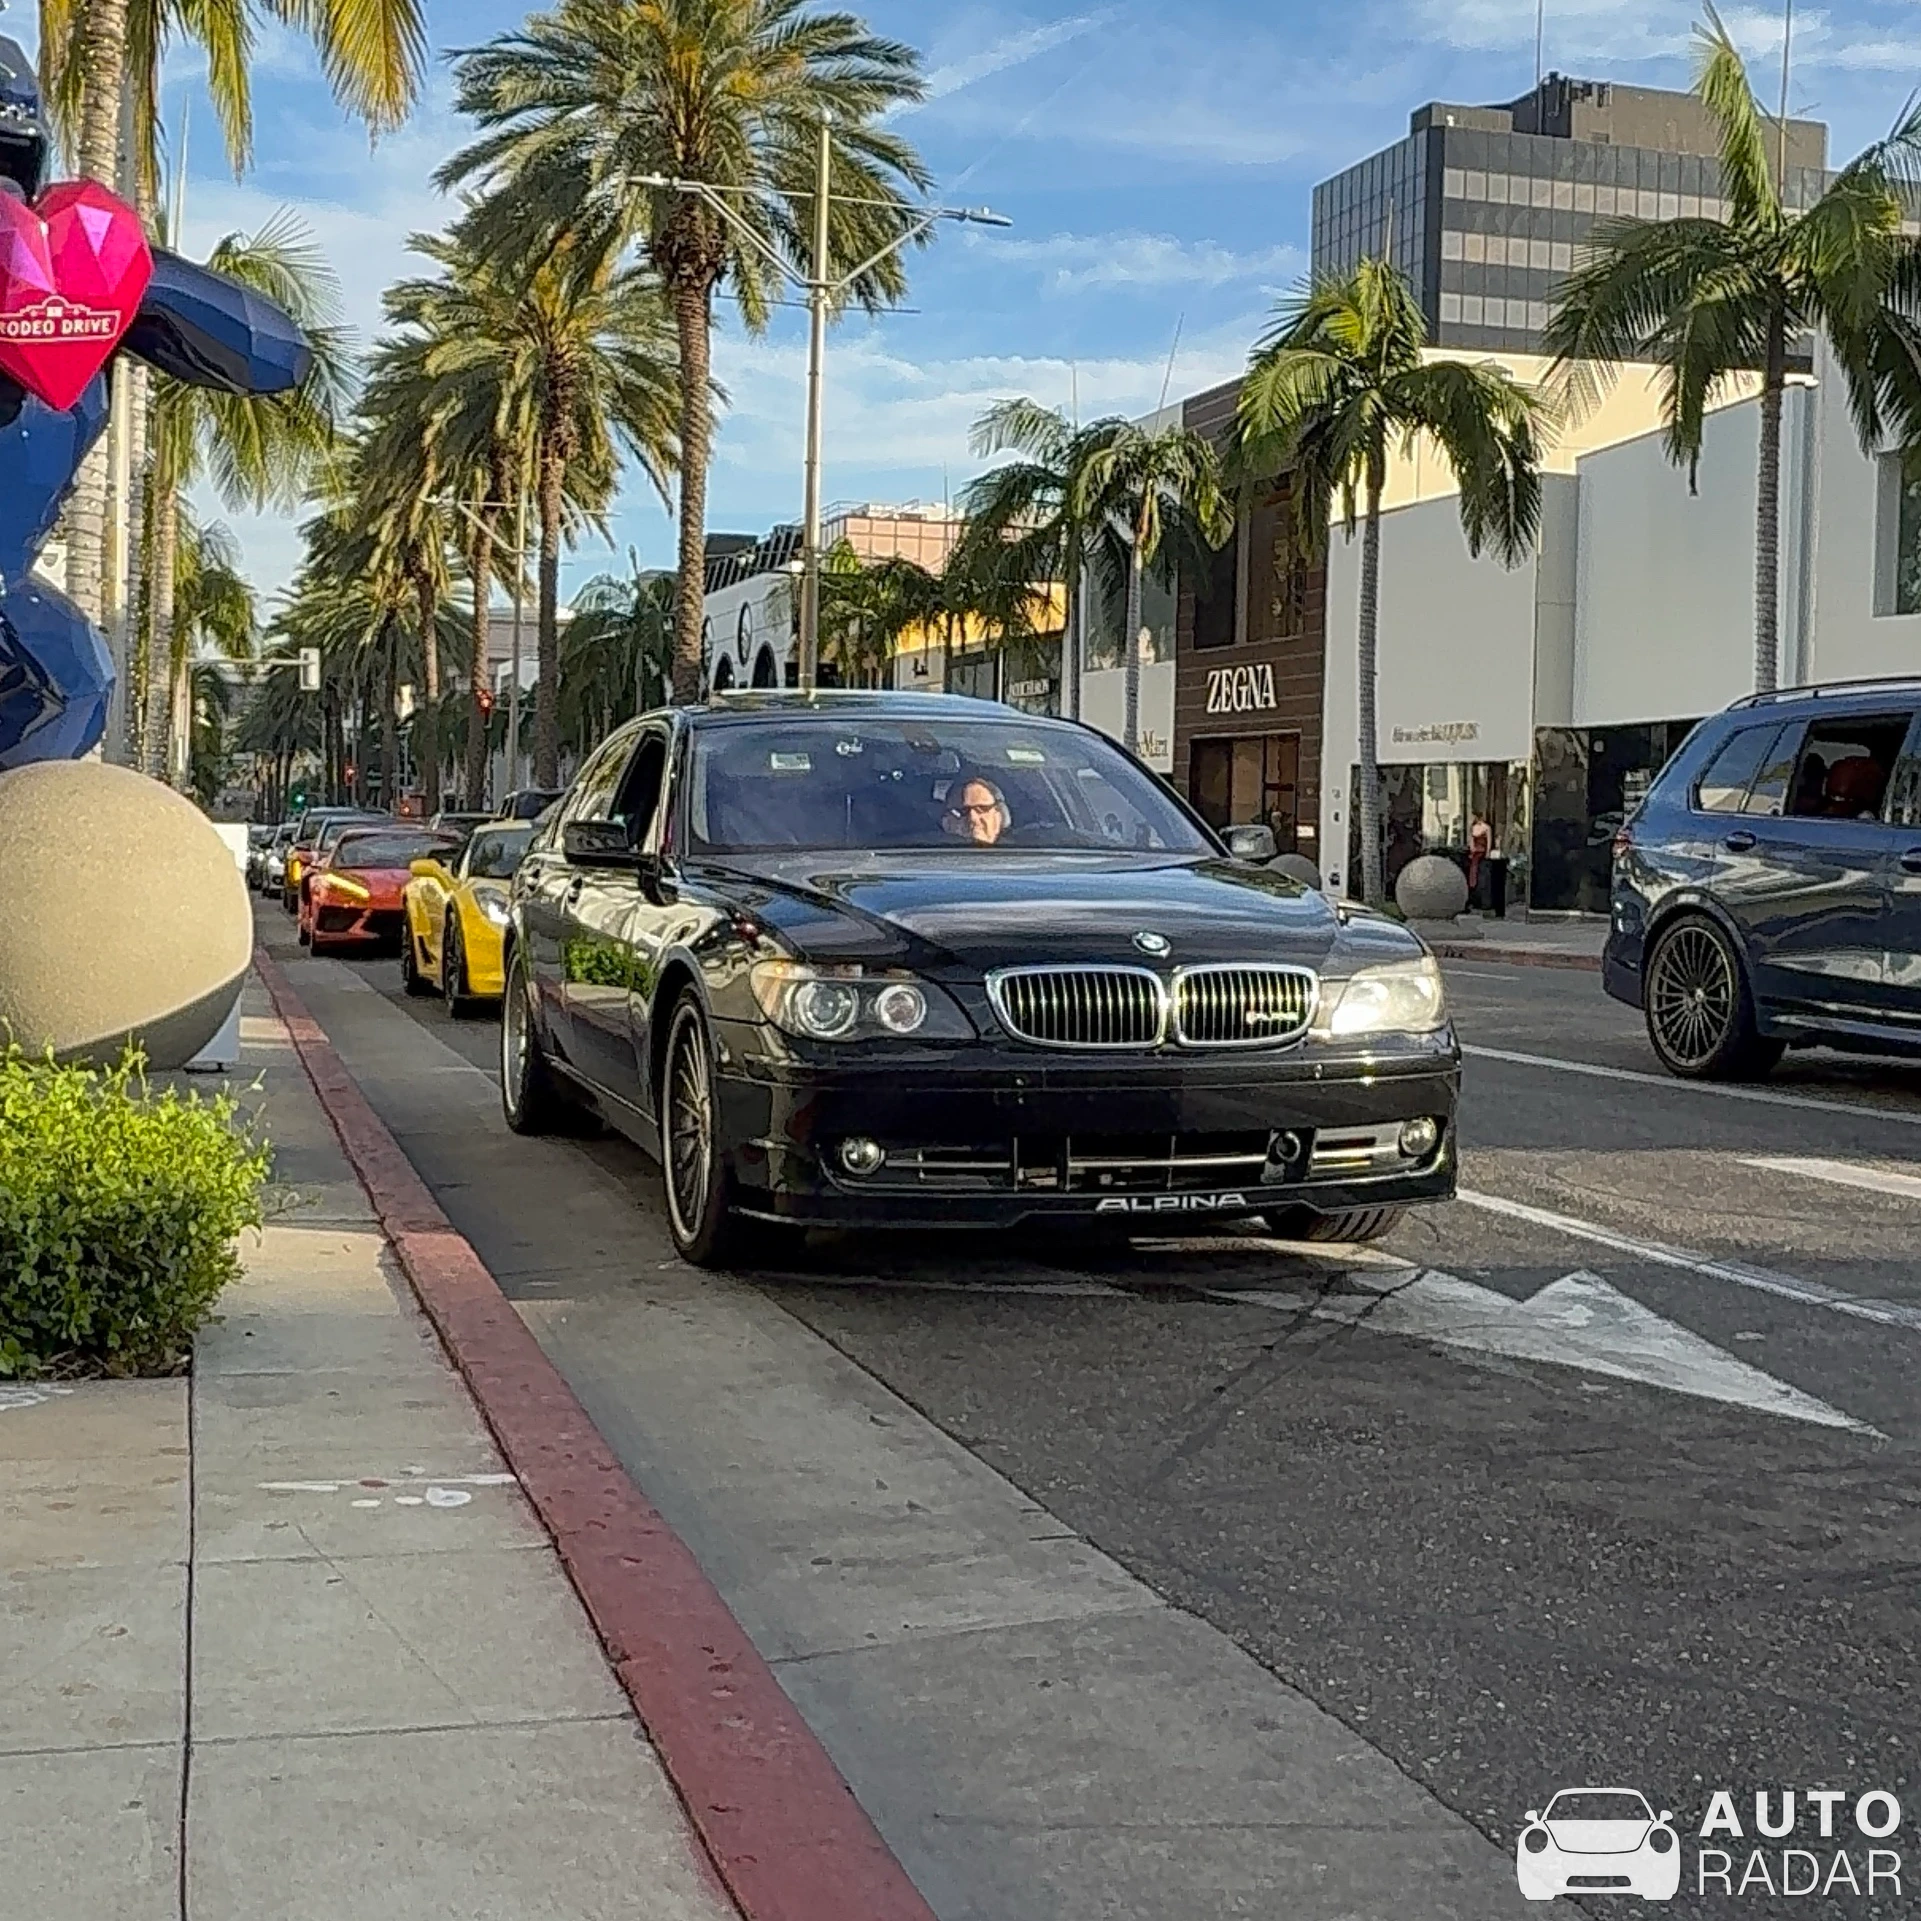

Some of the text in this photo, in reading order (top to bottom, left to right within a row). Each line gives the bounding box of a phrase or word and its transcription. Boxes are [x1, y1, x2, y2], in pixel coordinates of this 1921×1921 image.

[61, 318, 111, 335] DRIVE
[1206, 664, 1277, 714] ZEGNA
[1095, 1193, 1247, 1213] ALPINA
